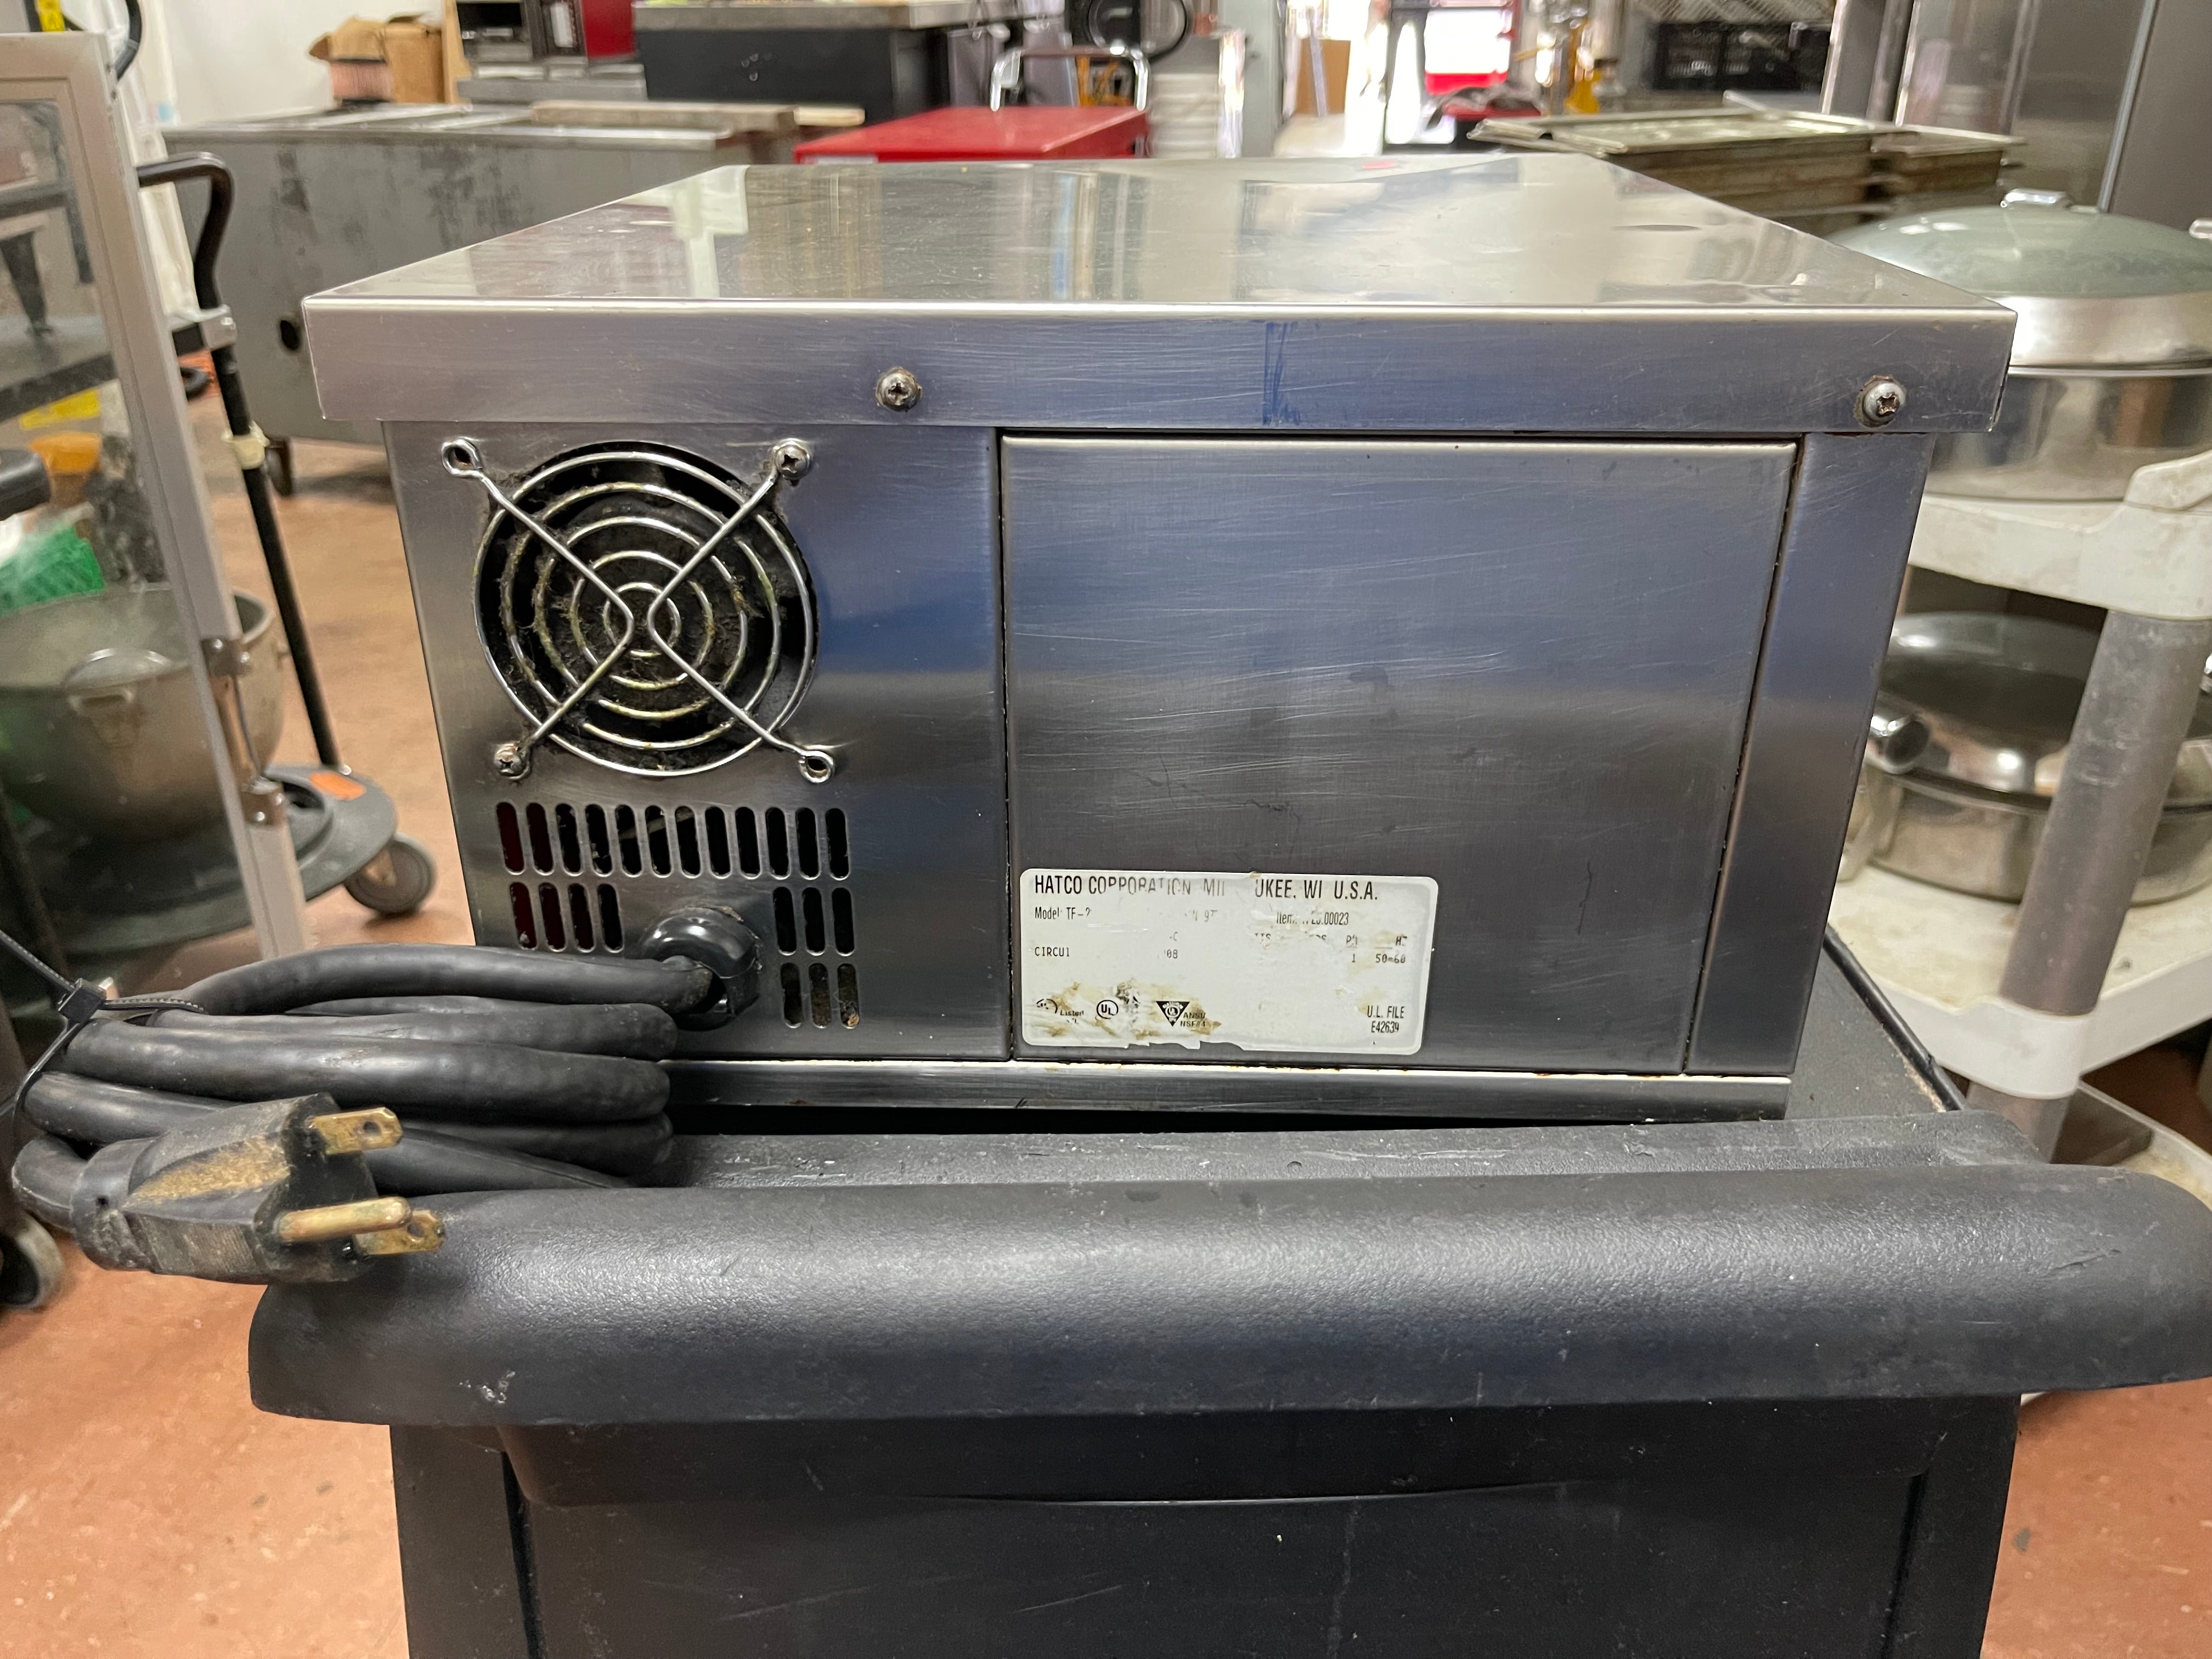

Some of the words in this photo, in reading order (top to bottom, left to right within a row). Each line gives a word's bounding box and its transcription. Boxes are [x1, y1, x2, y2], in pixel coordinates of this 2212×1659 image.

[1035, 874, 1082, 894] HATCO
[1304, 879, 1323, 899] WI
[1334, 880, 1378, 900] U.S.A.
[1375, 952, 1406, 964] 50-60
[1367, 1005, 1384, 1018] U.L.
[1386, 1006, 1405, 1019] FILE
[1371, 1020, 1400, 1034] E42639
